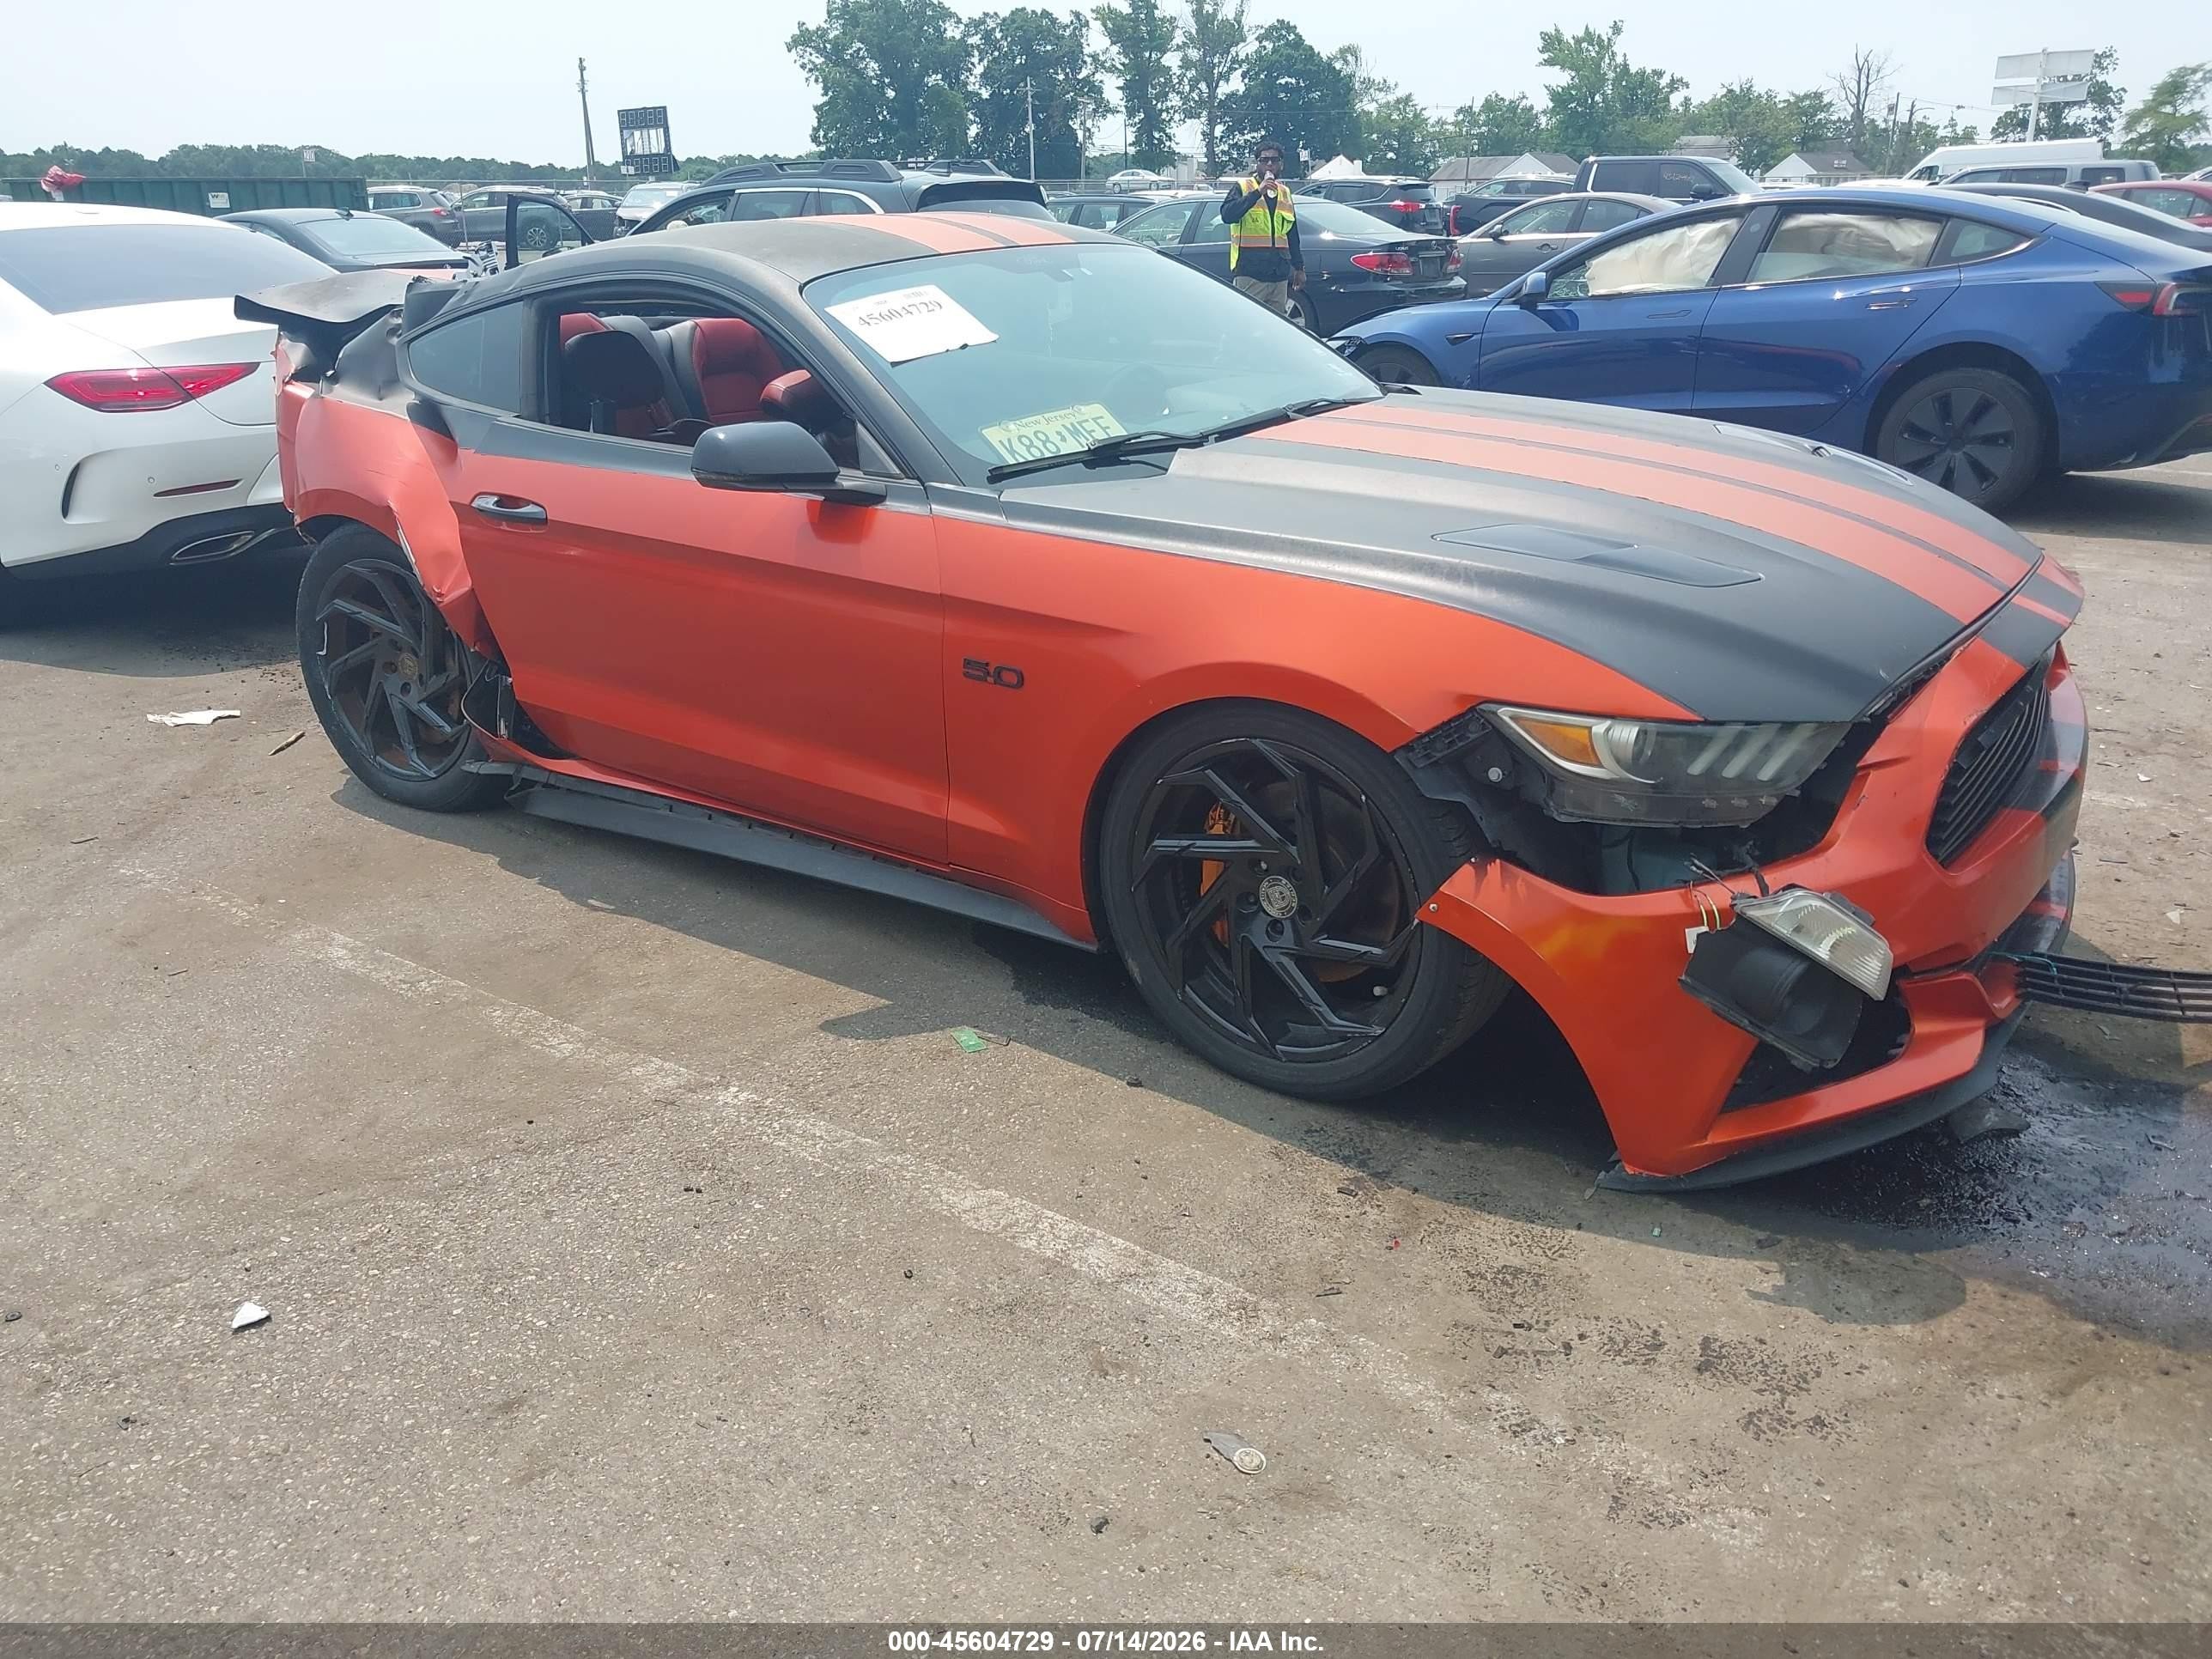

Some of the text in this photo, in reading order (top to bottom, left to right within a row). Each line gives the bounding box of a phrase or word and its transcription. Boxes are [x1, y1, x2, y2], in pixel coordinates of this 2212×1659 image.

[858, 300, 943, 326] 45604729
[1015, 412, 1078, 432] New Jersey
[999, 430, 1061, 462] K88
[963, 658, 1024, 689] 5.0
